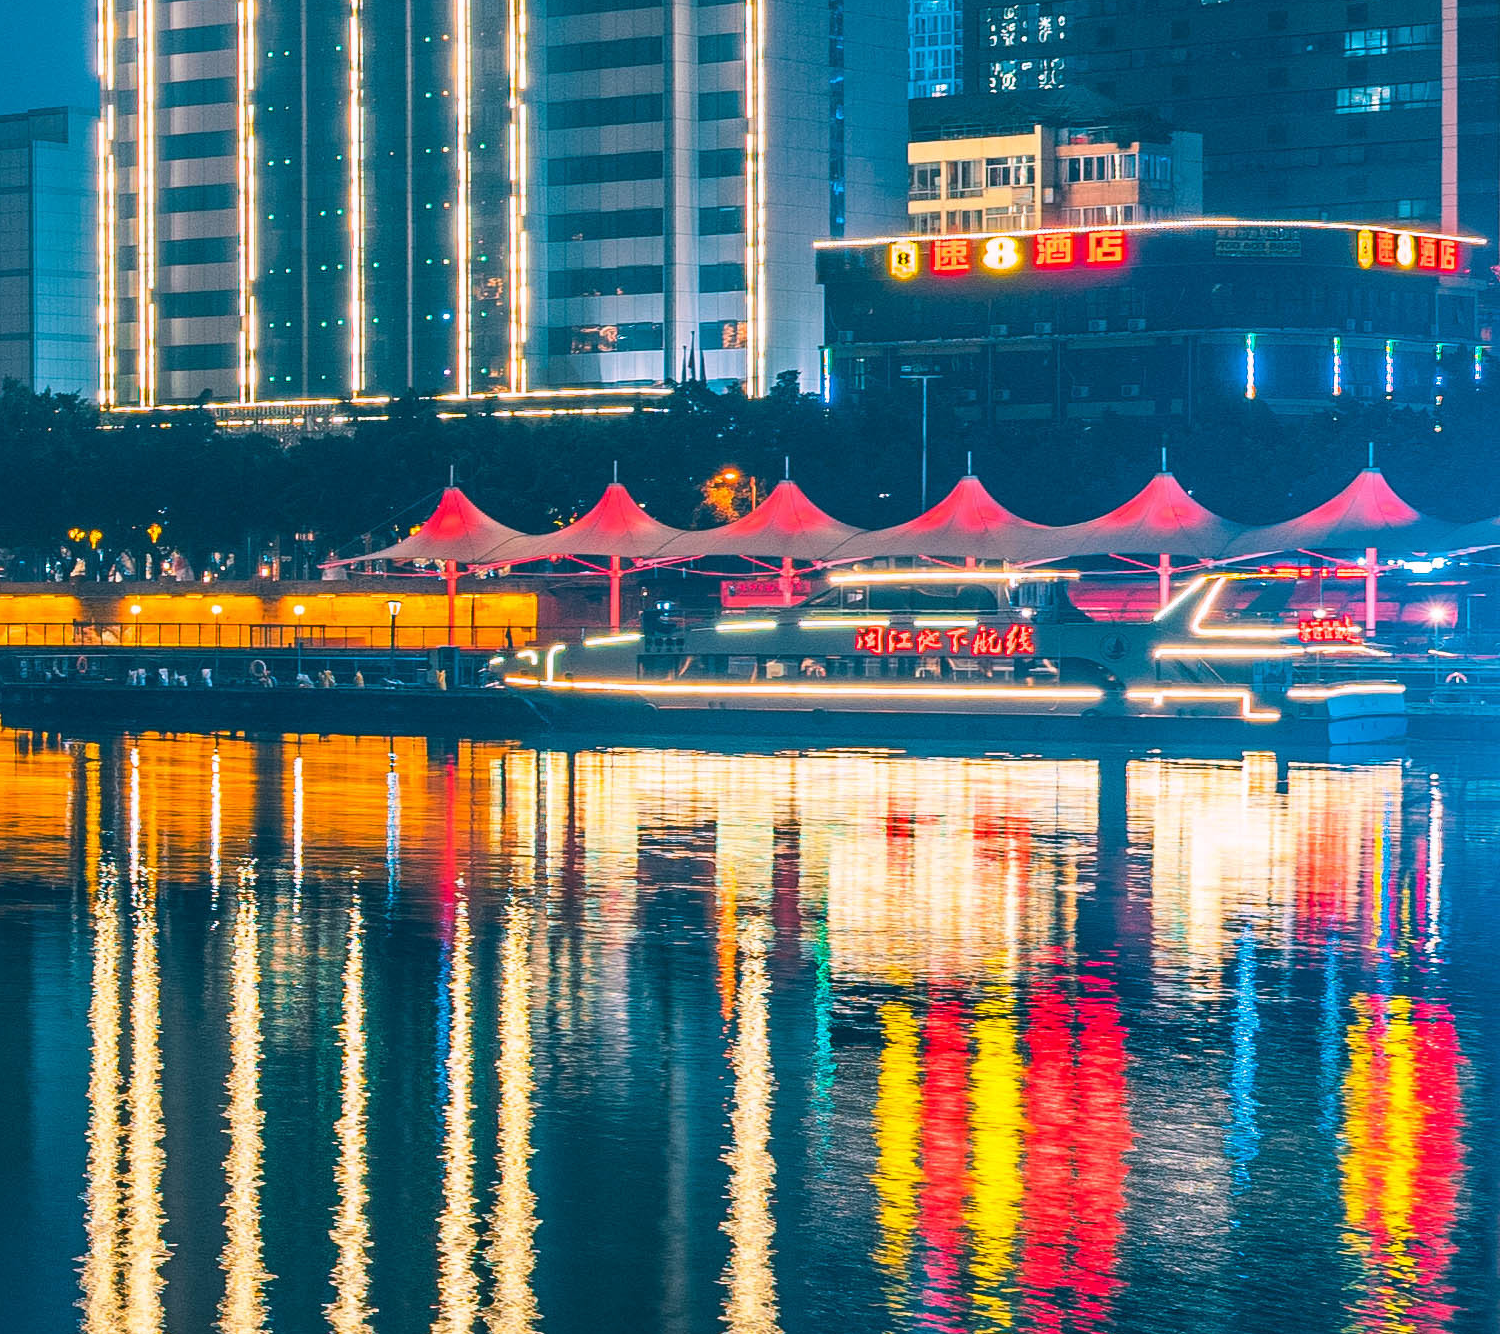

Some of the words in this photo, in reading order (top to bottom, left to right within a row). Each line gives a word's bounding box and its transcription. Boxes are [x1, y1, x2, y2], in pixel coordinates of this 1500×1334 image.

[933, 232, 1124, 271] 速8酒店
[1377, 232, 1456, 269] 速8酒店
